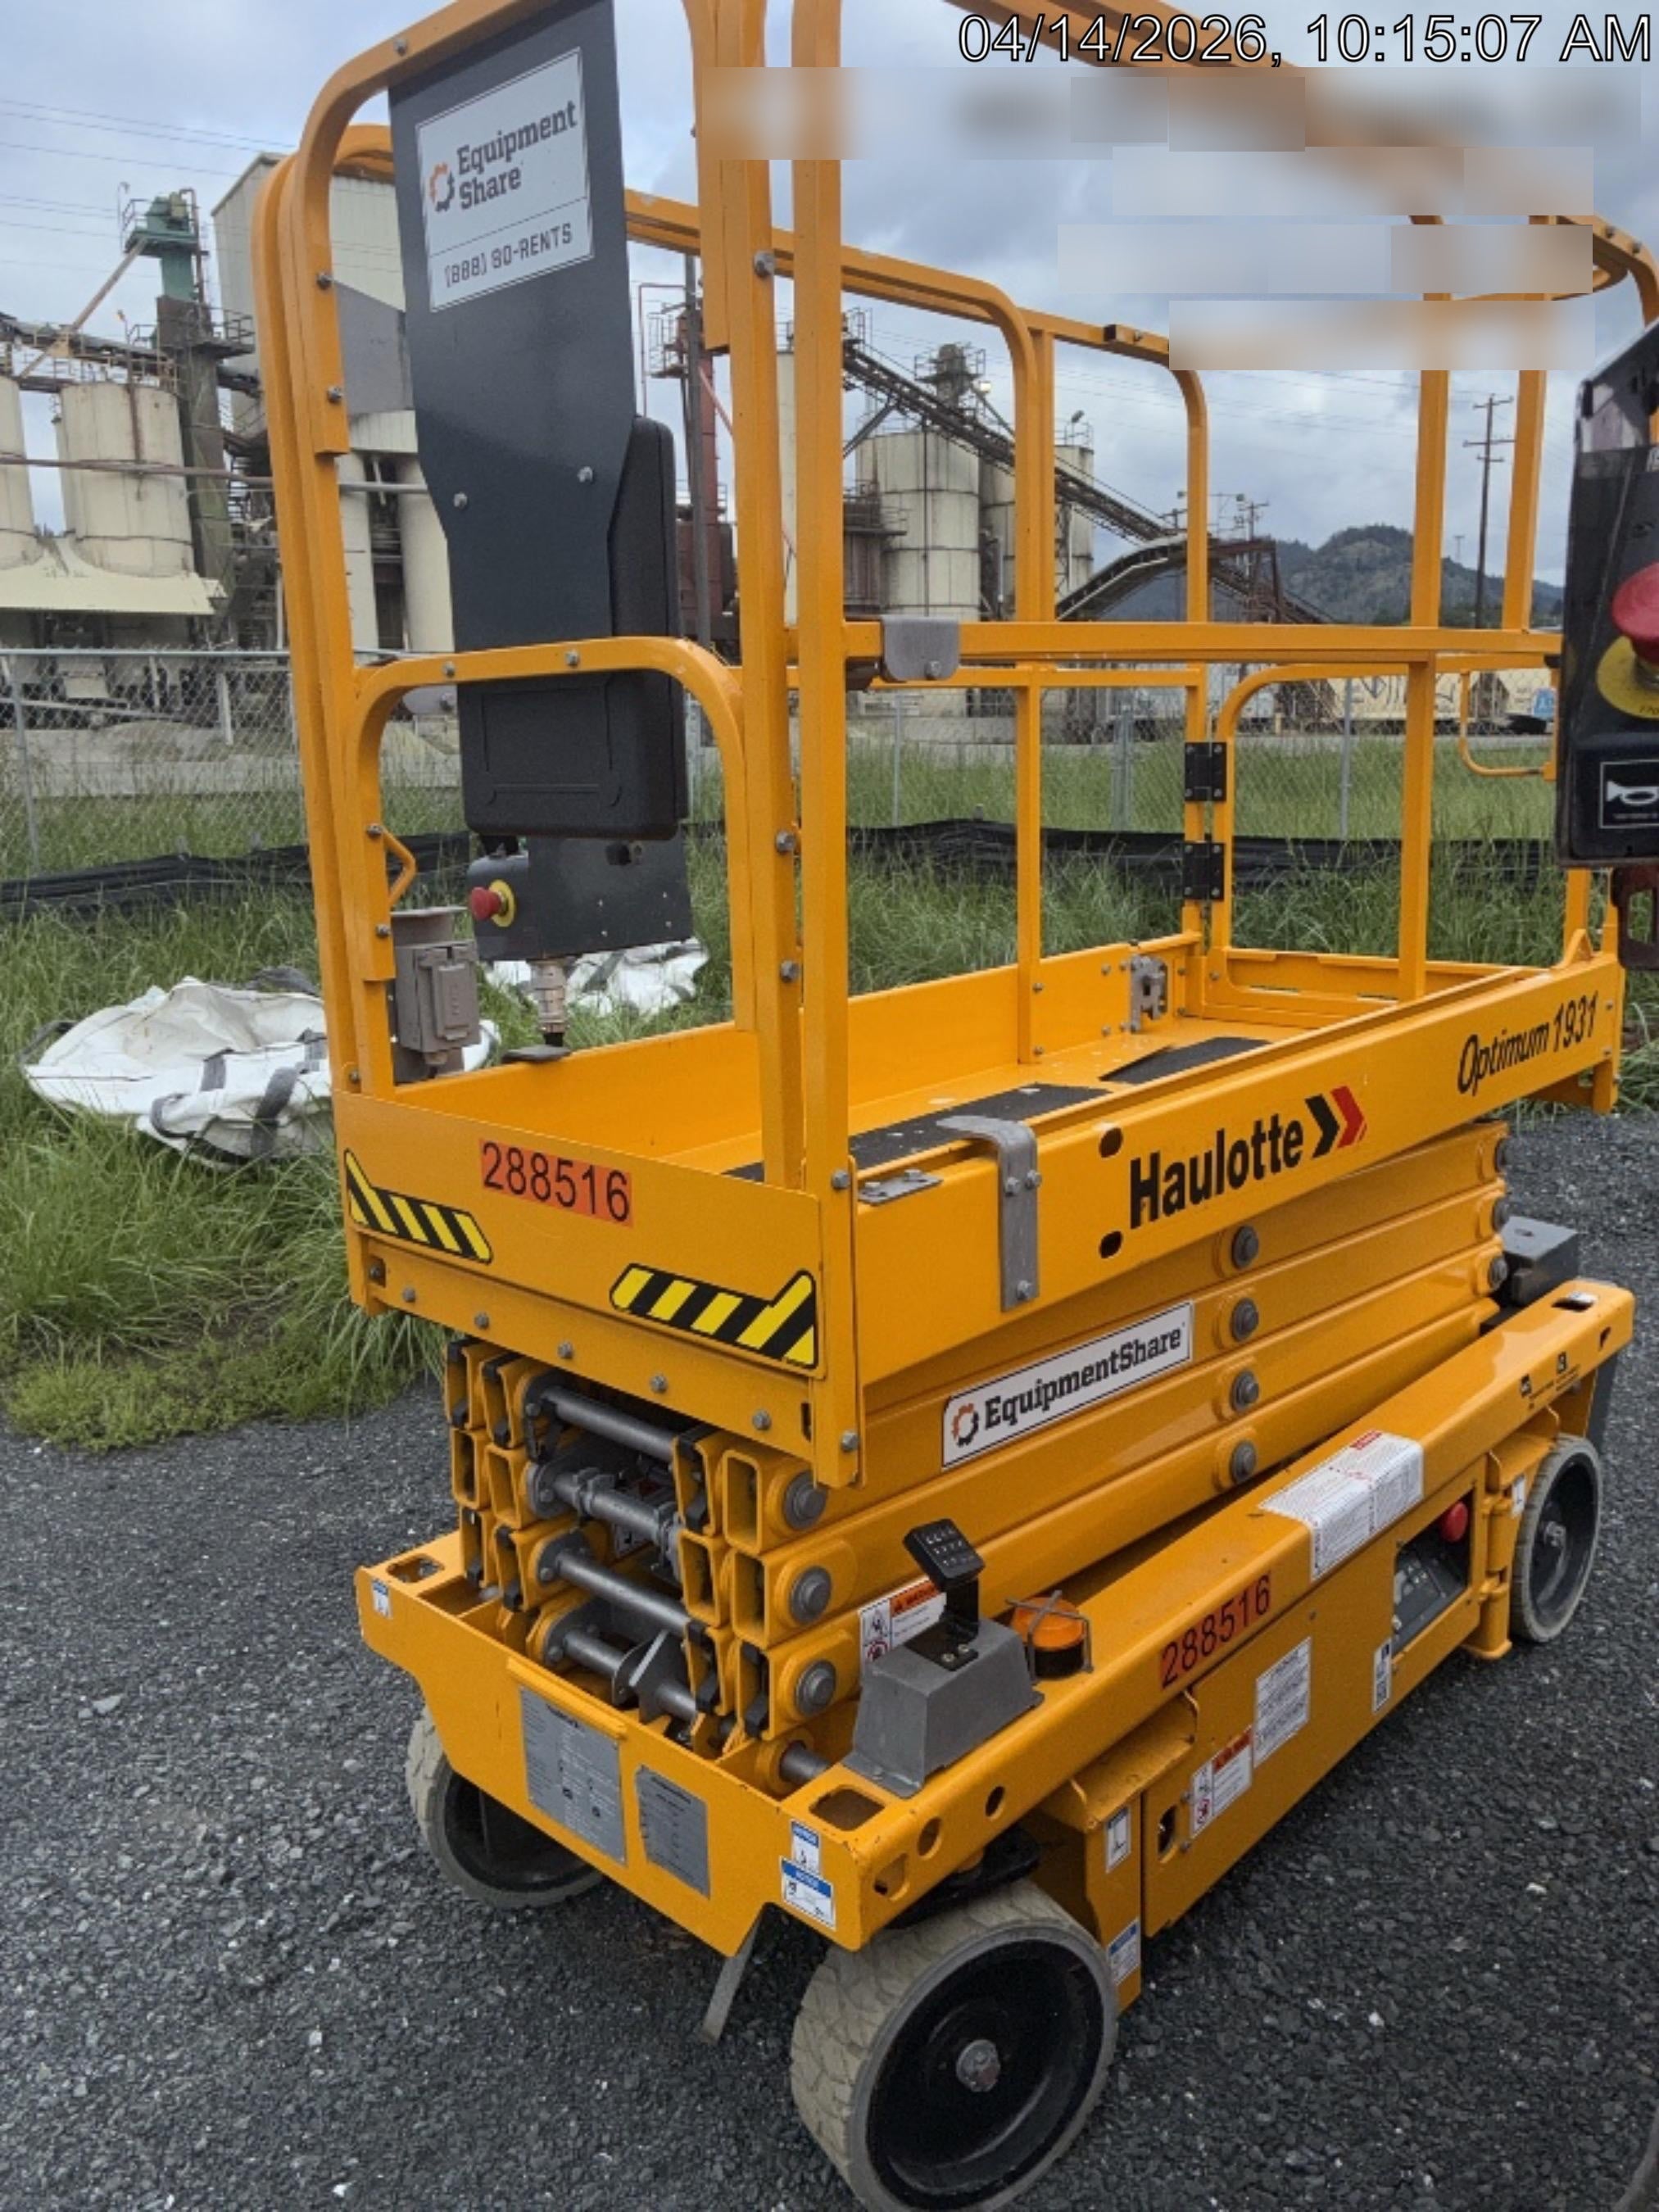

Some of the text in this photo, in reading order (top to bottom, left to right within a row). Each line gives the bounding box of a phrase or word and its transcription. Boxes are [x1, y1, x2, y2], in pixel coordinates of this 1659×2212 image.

[456, 100, 577, 176] Equipment
[459, 165, 522, 211] Share
[445, 256, 488, 288] (888)
[1457, 993, 1600, 1095] Optimum 1931
[483, 1142, 630, 1222] 288516
[1130, 1113, 1303, 1230] Haulotte
[985, 1327, 1182, 1430] EquipmentShare
[1162, 1574, 1271, 1690] 288516
